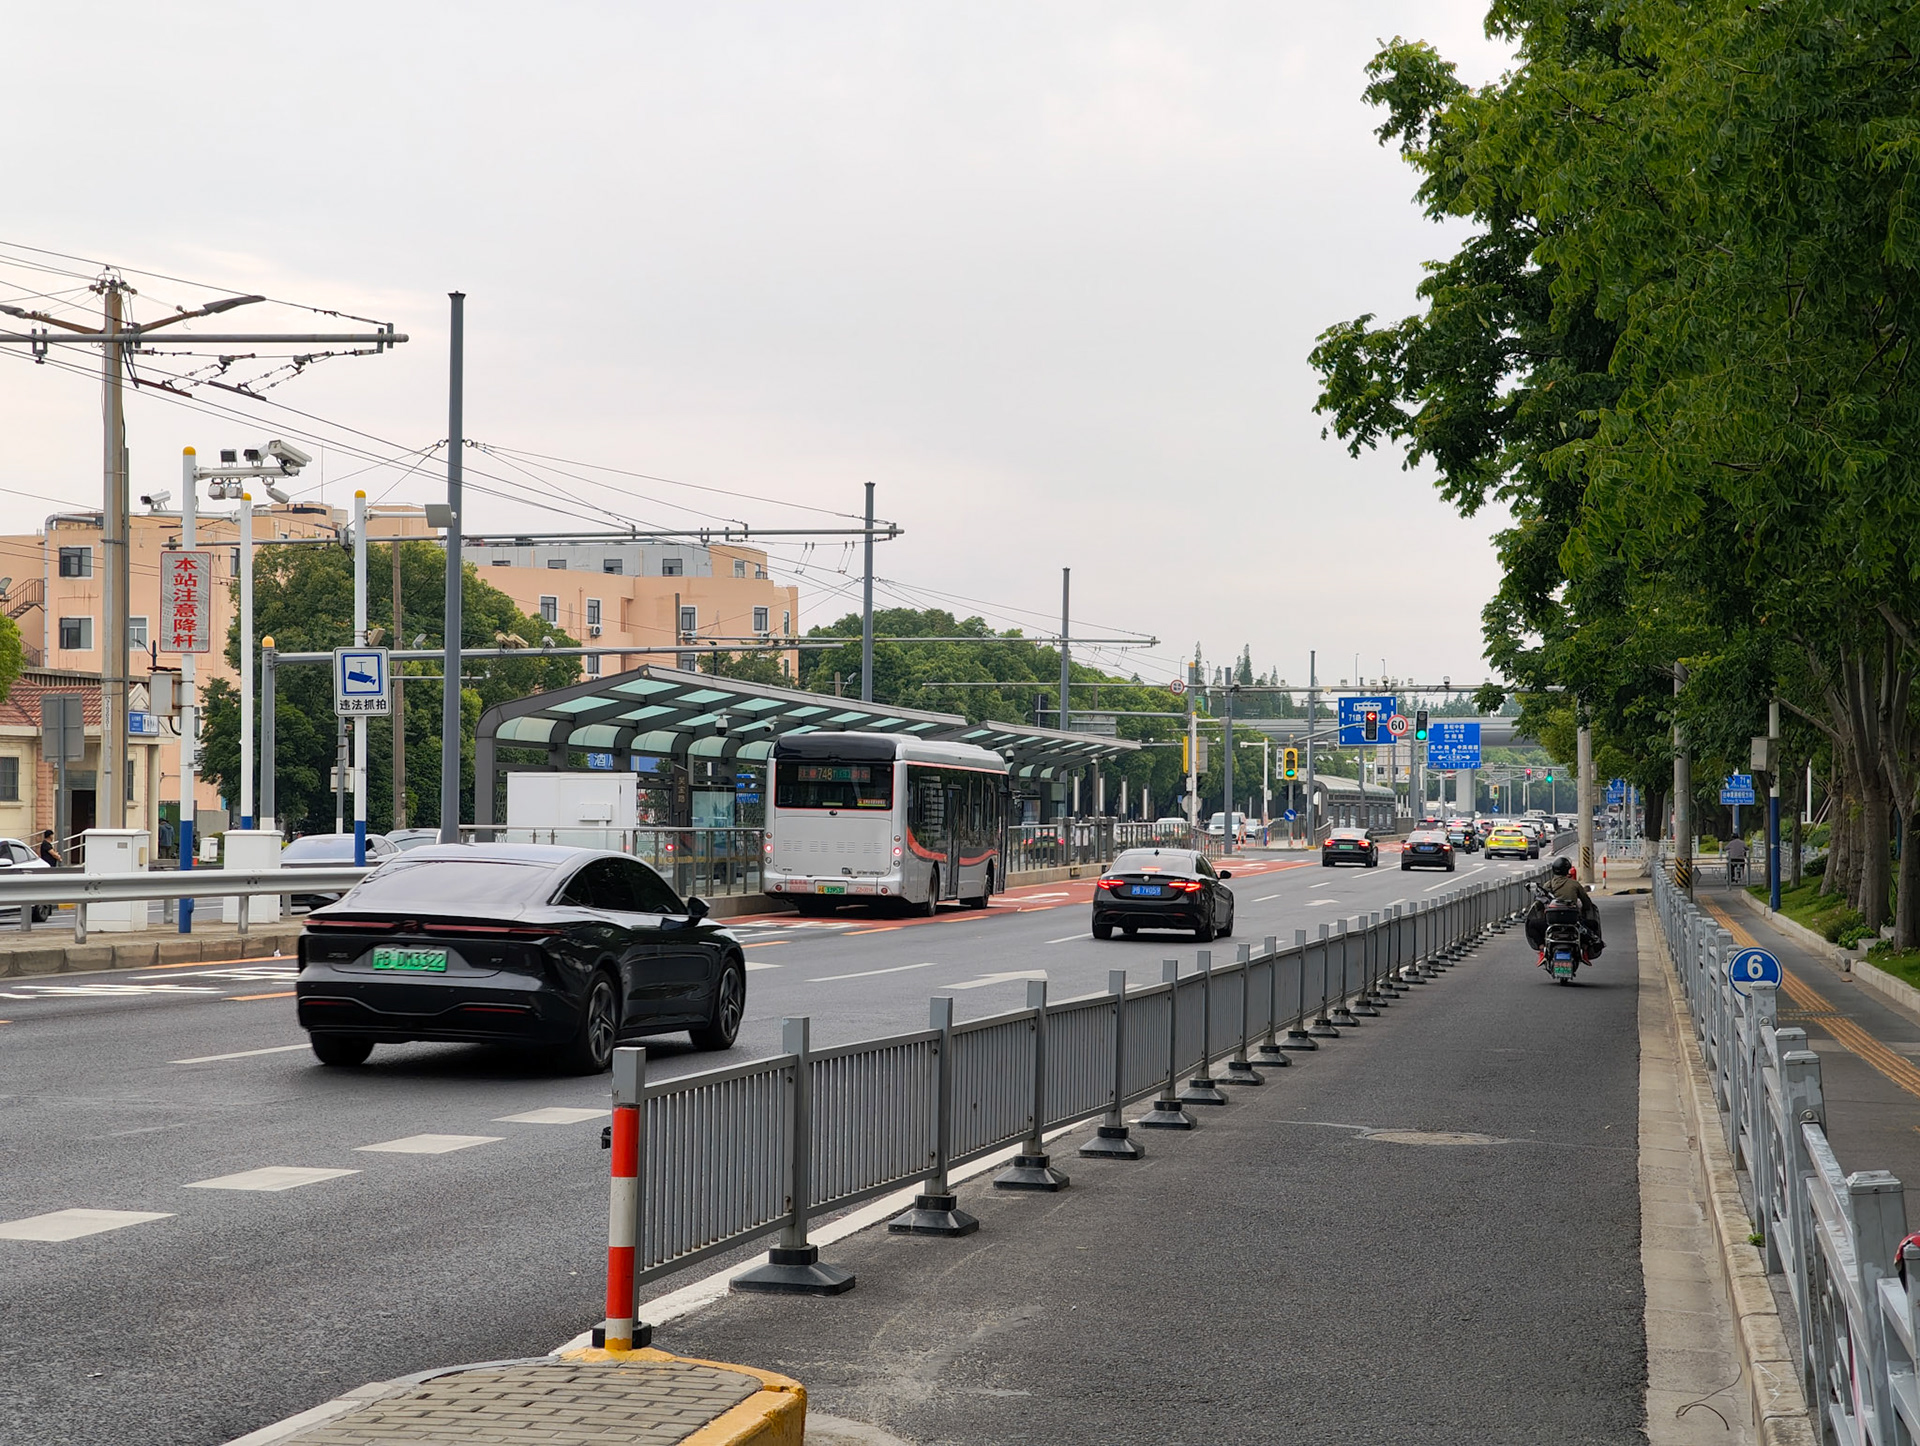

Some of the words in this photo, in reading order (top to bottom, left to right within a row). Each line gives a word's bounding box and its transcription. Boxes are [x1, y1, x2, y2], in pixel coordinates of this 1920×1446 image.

[173, 557, 198, 648] 本站注意降杆
[339, 699, 387, 711] 违法抓拍
[1391, 720, 1405, 731] 60
[817, 767, 833, 781] 748
[1747, 954, 1763, 979] 6
